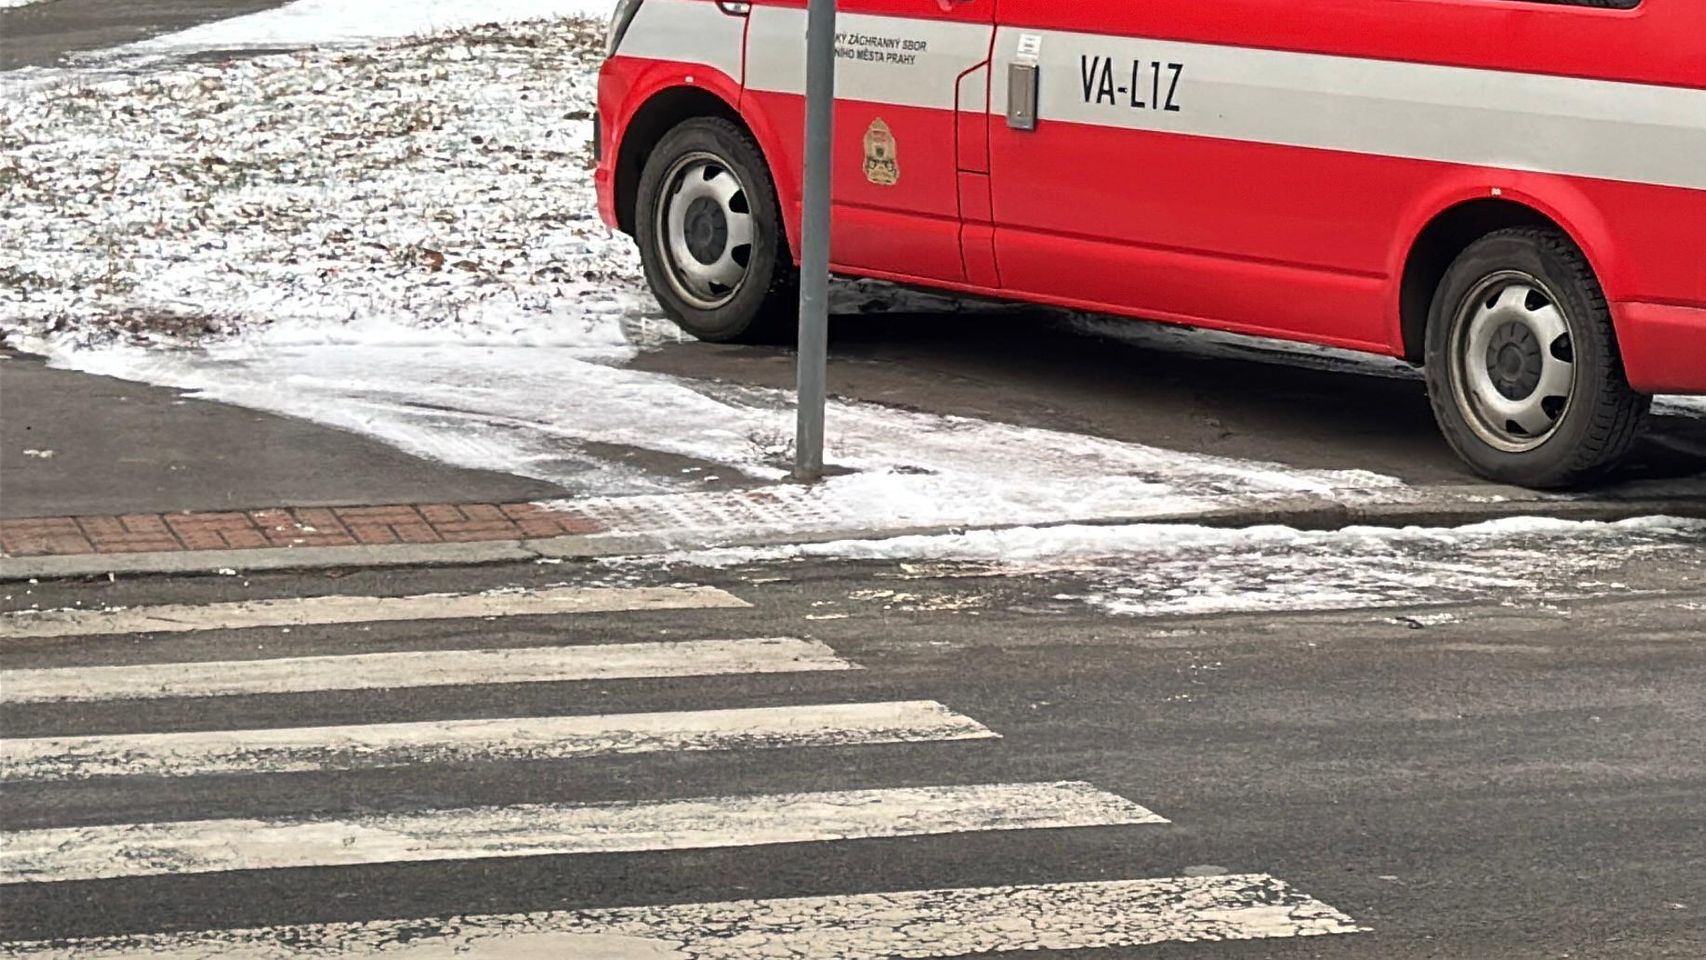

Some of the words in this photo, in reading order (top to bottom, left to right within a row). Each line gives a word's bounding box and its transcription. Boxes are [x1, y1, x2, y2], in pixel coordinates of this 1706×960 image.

[848, 33, 901, 49] ZÁCHRANNÝ
[902, 40, 927, 51] SBOR
[857, 47, 885, 62] MĚSTA
[886, 53, 915, 65] PRAHY
[1081, 54, 1183, 112] VA-L1Z
